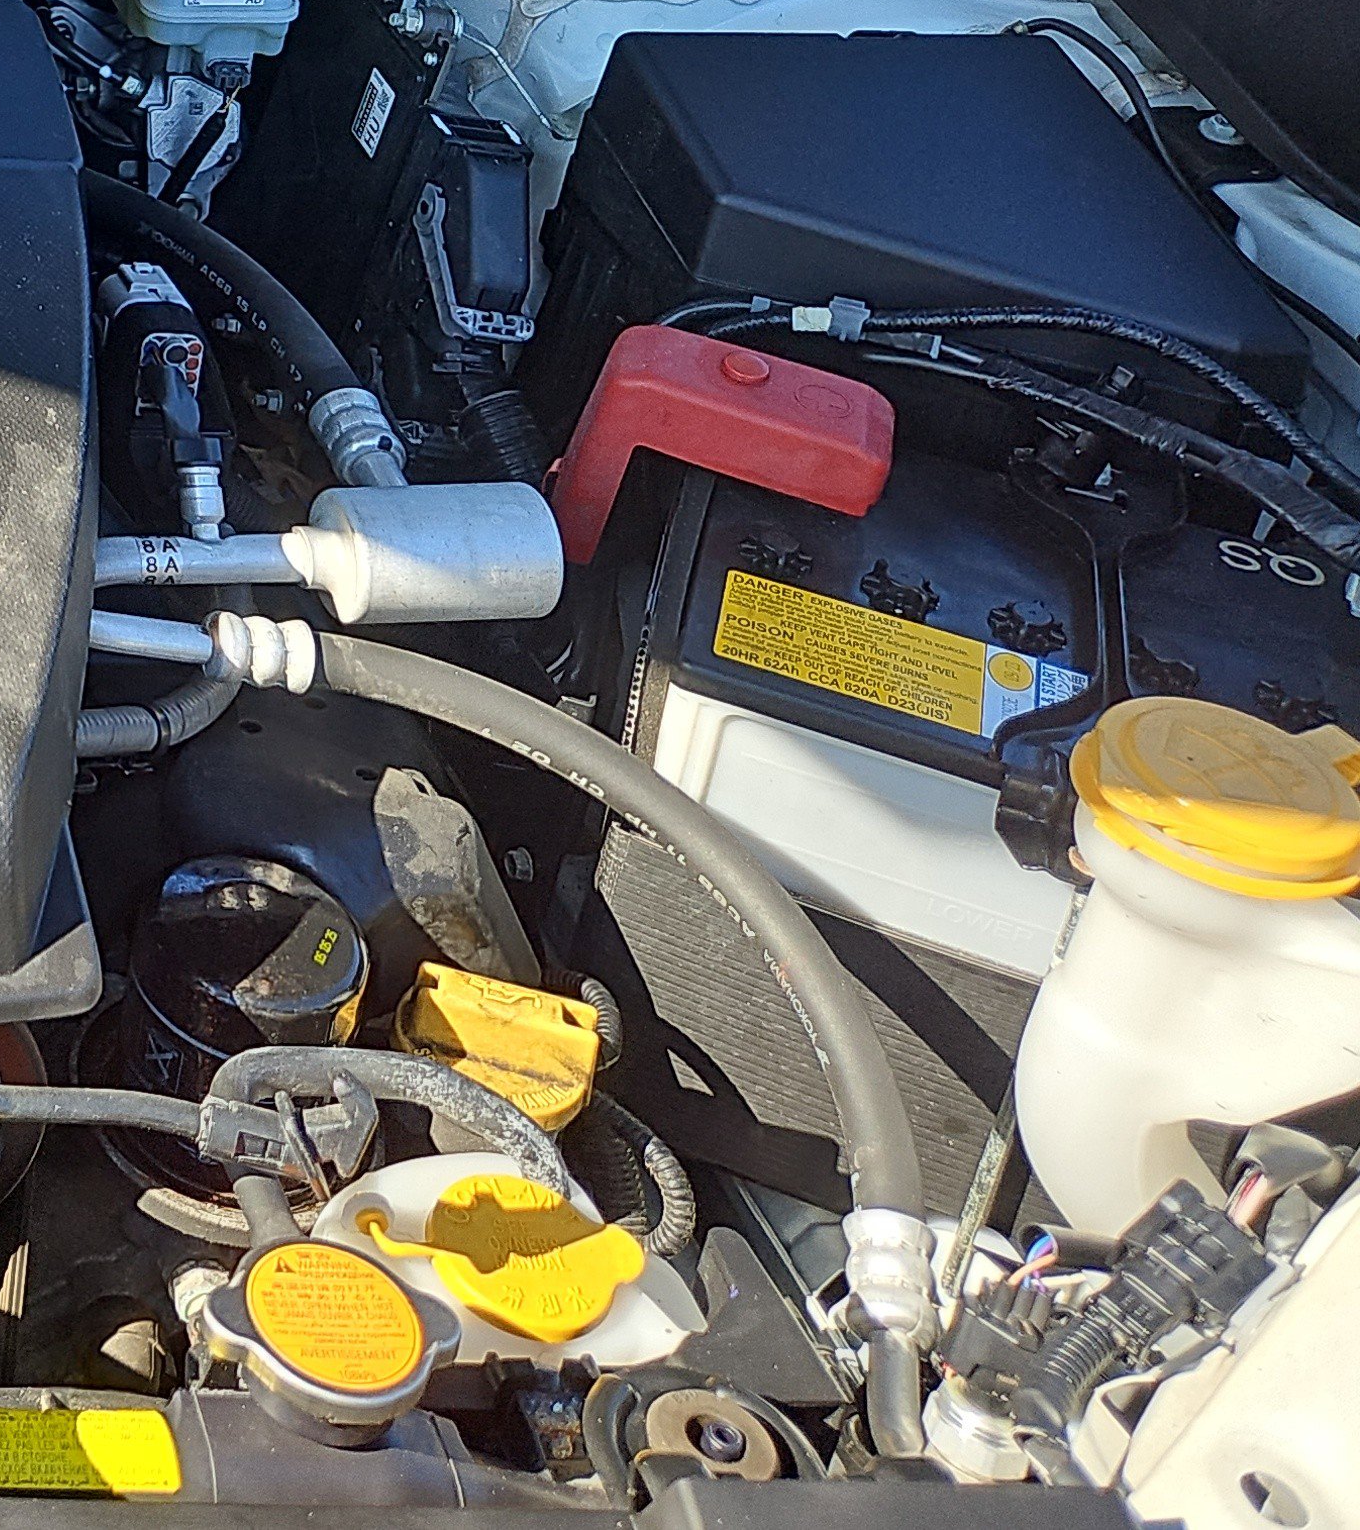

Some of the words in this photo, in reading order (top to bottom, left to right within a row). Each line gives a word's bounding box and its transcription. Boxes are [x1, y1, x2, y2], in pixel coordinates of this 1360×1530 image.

[732, 573, 804, 601] DANGER
[810, 596, 865, 619] EXPLOSIVE
[867, 612, 903, 629] GASES
[725, 612, 794, 641] POISON
[804, 636, 847, 656] CAUSES
[849, 650, 889, 669] SEVERE
[892, 663, 928, 681] BURNS
[779, 618, 807, 633] KEEP
[808, 627, 836, 642] VENT
[837, 636, 866, 651] CAPS
[868, 644, 898, 661] TIGHT
[900, 654, 923, 668] AND
[924, 662, 957, 679] LEVEL
[721, 643, 760, 664] 20HR
[762, 656, 800, 676] 62Ah
[807, 669, 841, 689] CCA
[887, 694, 949, 722] D23(JIS)
[773, 649, 802, 665] KEEP
[803, 658, 824, 672] OUT
[827, 665, 841, 677] OF
[844, 671, 880, 689] REACH
[882, 682, 897, 694] OF
[899, 688, 952, 711] CHILDREN
[1041, 665, 1056, 696] START
[569, 770, 605, 798] CH
[924, 897, 1033, 941] LOWER
[762, 948, 819, 1048] YOKOHAMA
[512, 1084, 570, 1109] MANUAL
